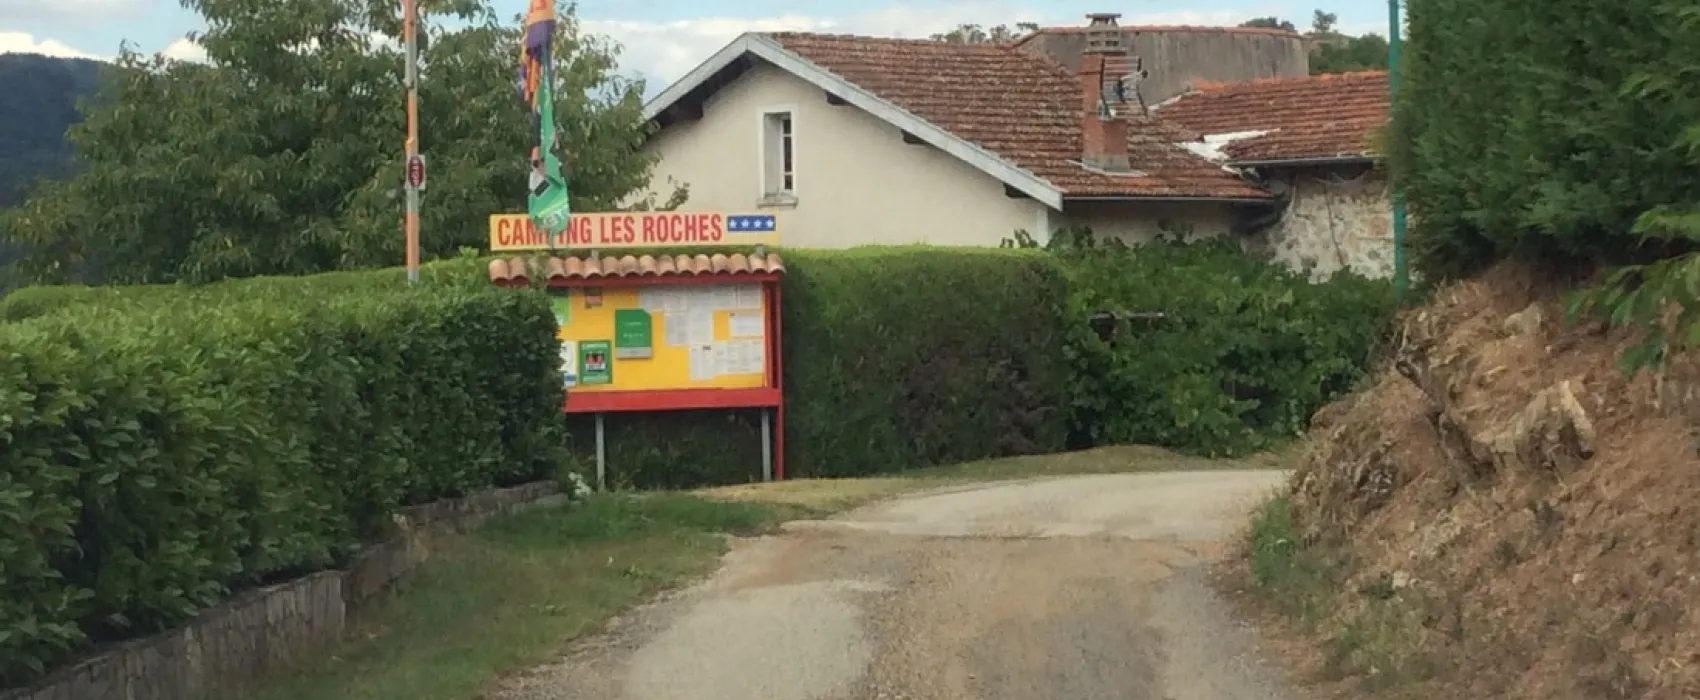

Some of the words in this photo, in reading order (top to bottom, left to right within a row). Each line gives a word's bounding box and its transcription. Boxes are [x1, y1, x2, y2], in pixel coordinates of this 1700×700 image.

[497, 217, 592, 246] CAMNG
[600, 214, 635, 244] LES
[643, 213, 723, 242] ROCHES
